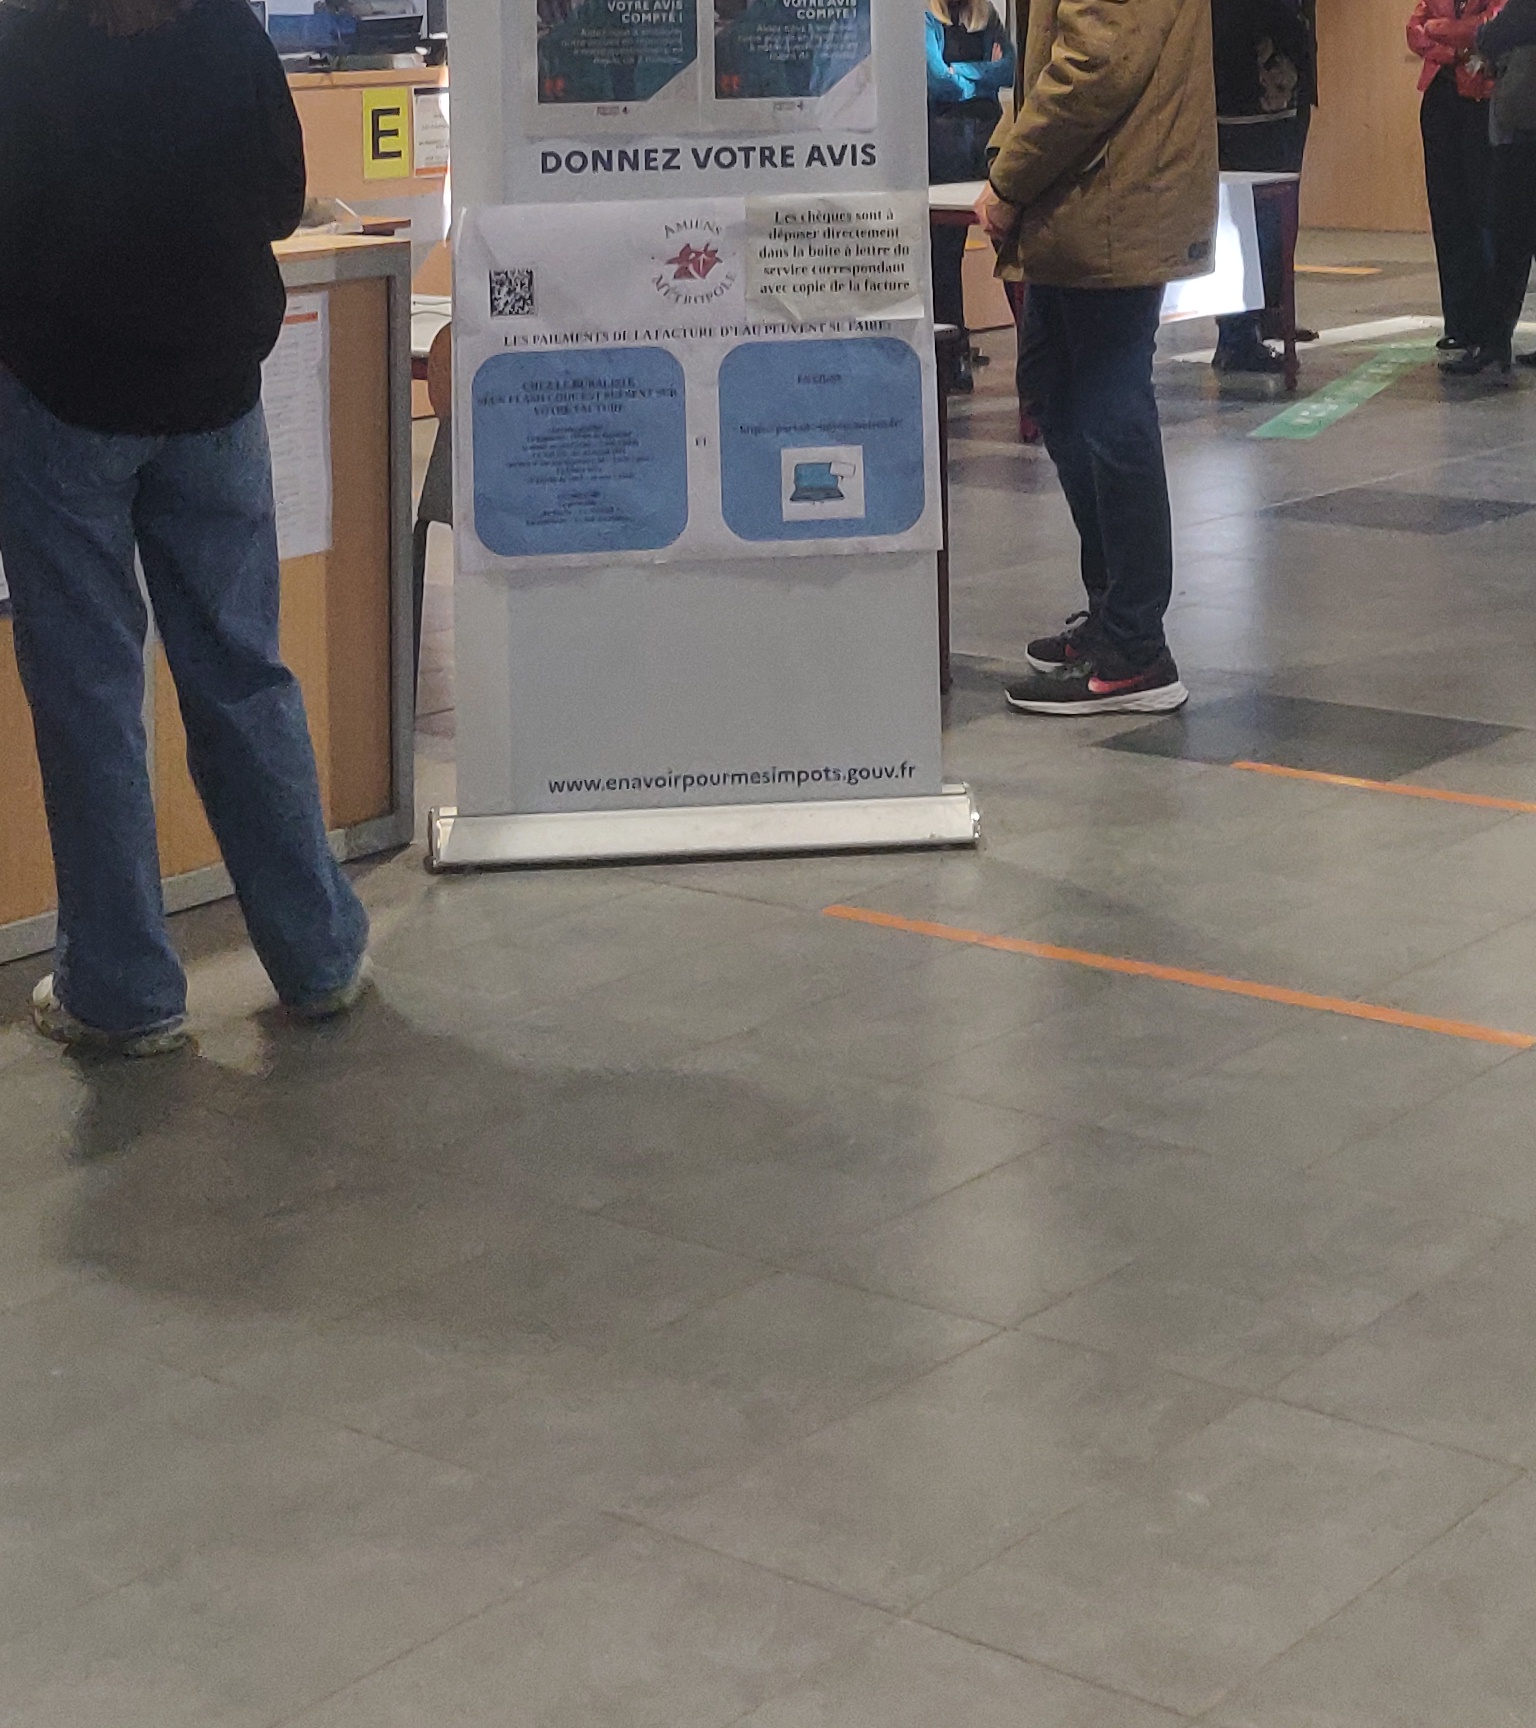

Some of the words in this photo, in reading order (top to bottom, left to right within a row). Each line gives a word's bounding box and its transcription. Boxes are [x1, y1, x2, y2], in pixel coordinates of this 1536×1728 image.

[608, 0, 649, 12] VOTRE
[796, 8, 851, 20] COMPTE
[372, 107, 403, 160] E
[541, 147, 681, 174] DONNEZ
[691, 145, 795, 169] VOTRE
[805, 143, 876, 168] AVIS
[775, 211, 796, 224] Les
[801, 210, 851, 224] chèques
[856, 210, 881, 220] sont
[886, 208, 894, 220] à
[769, 227, 819, 242] déposer
[823, 227, 899, 239] directement
[759, 246, 789, 258] dans
[793, 245, 804, 257] la
[856, 244, 890, 256] lettre
[894, 243, 910, 256] du
[763, 264, 807, 277] service
[812, 261, 905, 277] correspondant
[760, 283, 787, 294] avec
[793, 281, 826, 296] copie
[830, 279, 844, 292] de
[849, 279, 860, 292] la
[865, 279, 909, 291] facture
[504, 335, 529, 346] LES
[548, 763, 916, 794] www.enavoirpourmesimpots.gouv.fr
